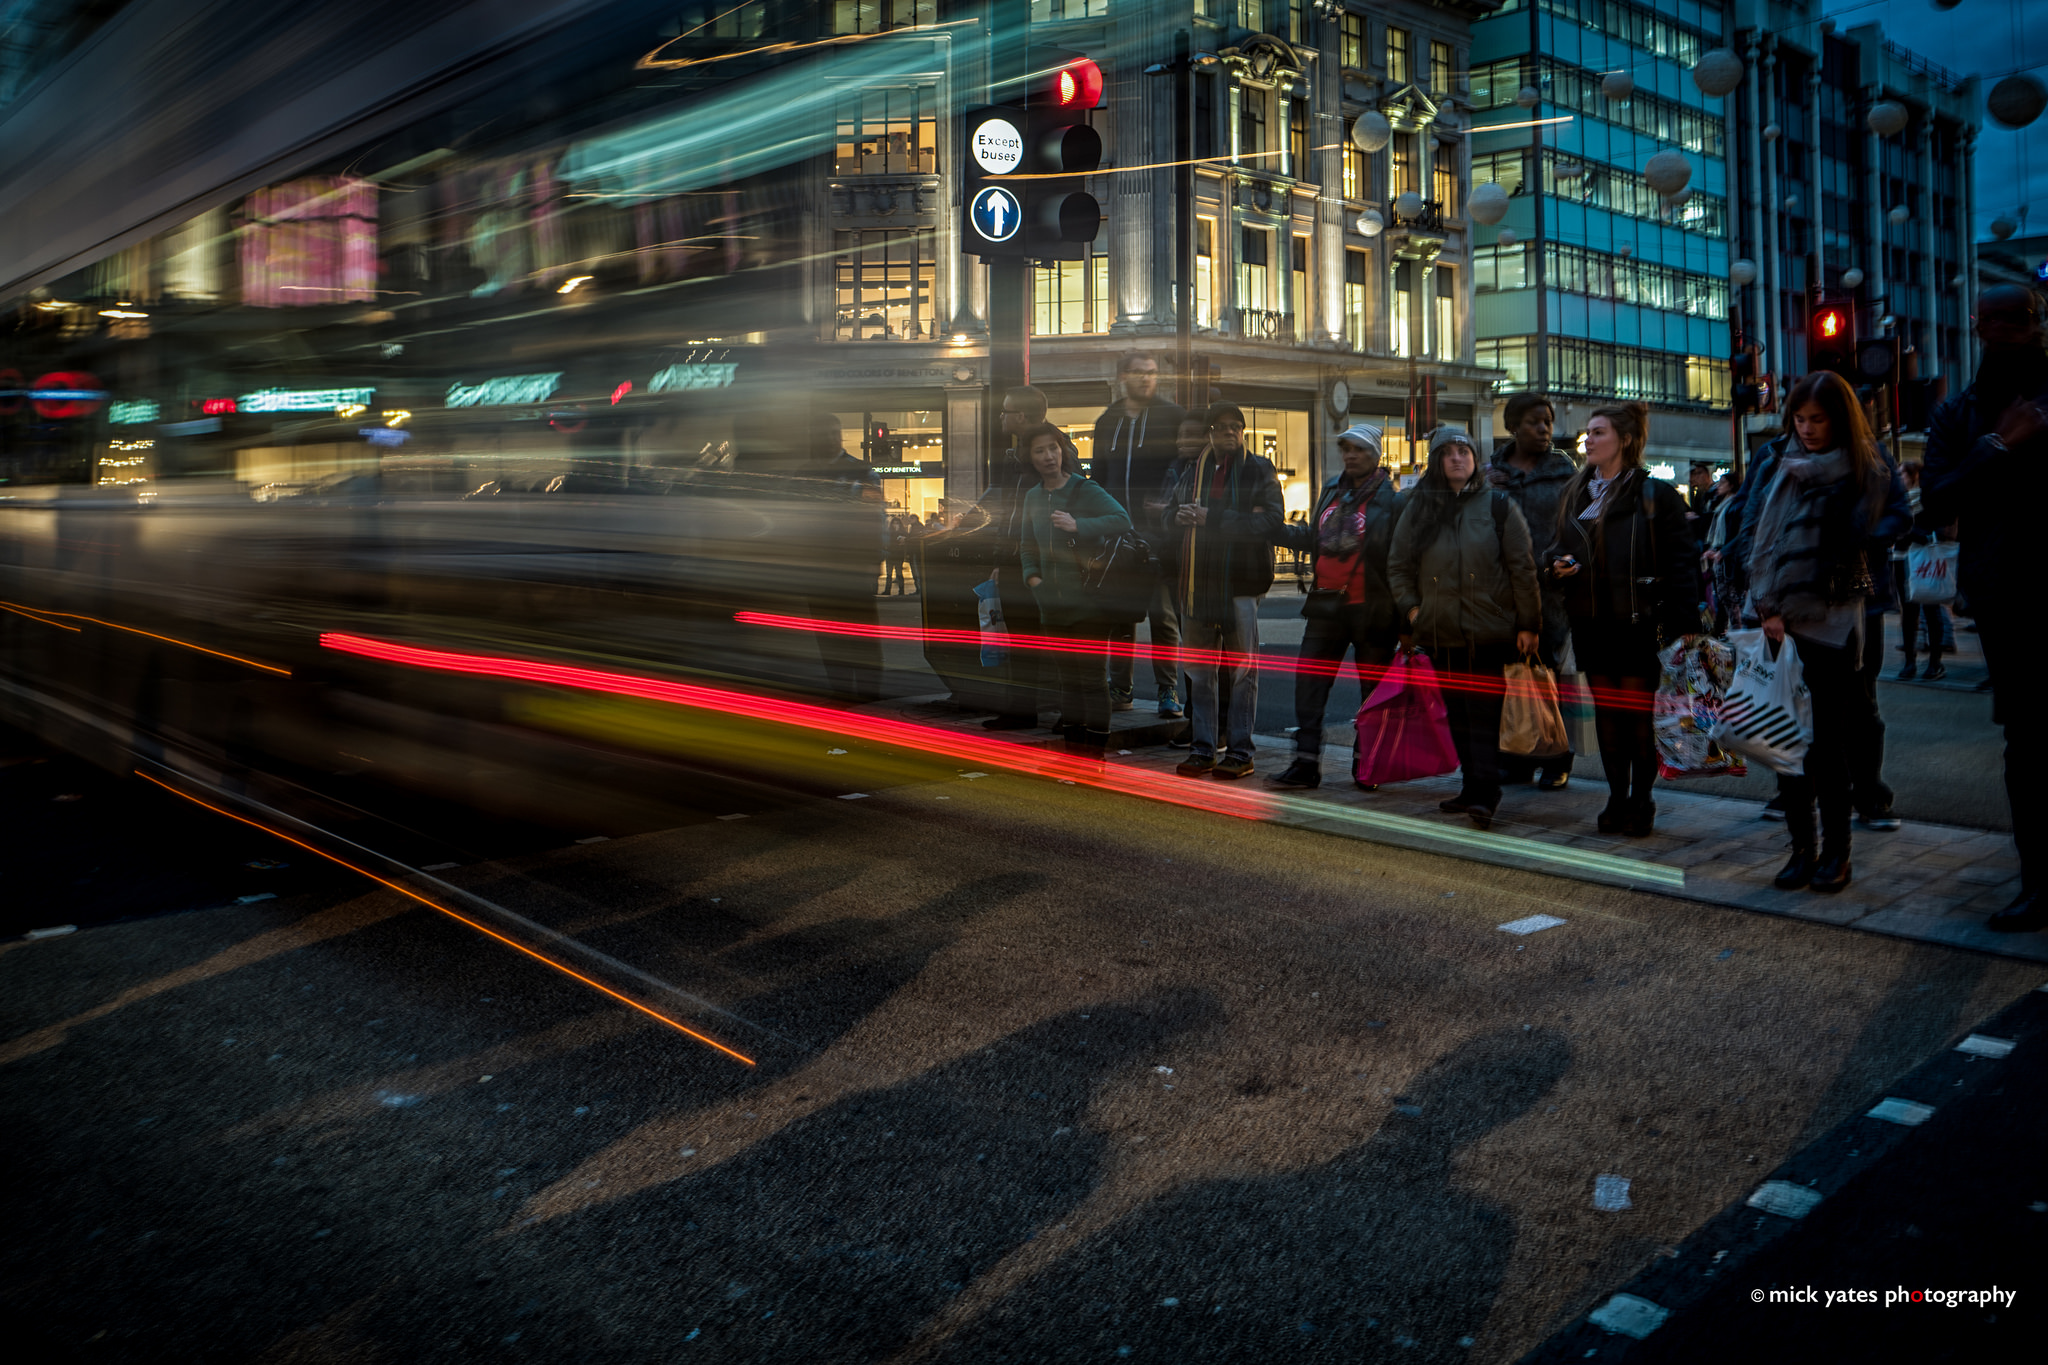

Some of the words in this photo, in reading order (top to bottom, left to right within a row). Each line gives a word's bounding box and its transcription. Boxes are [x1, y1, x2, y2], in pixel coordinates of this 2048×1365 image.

[978, 134, 1019, 149] Except
[981, 149, 1017, 162] buses
[883, 369, 895, 378] OF
